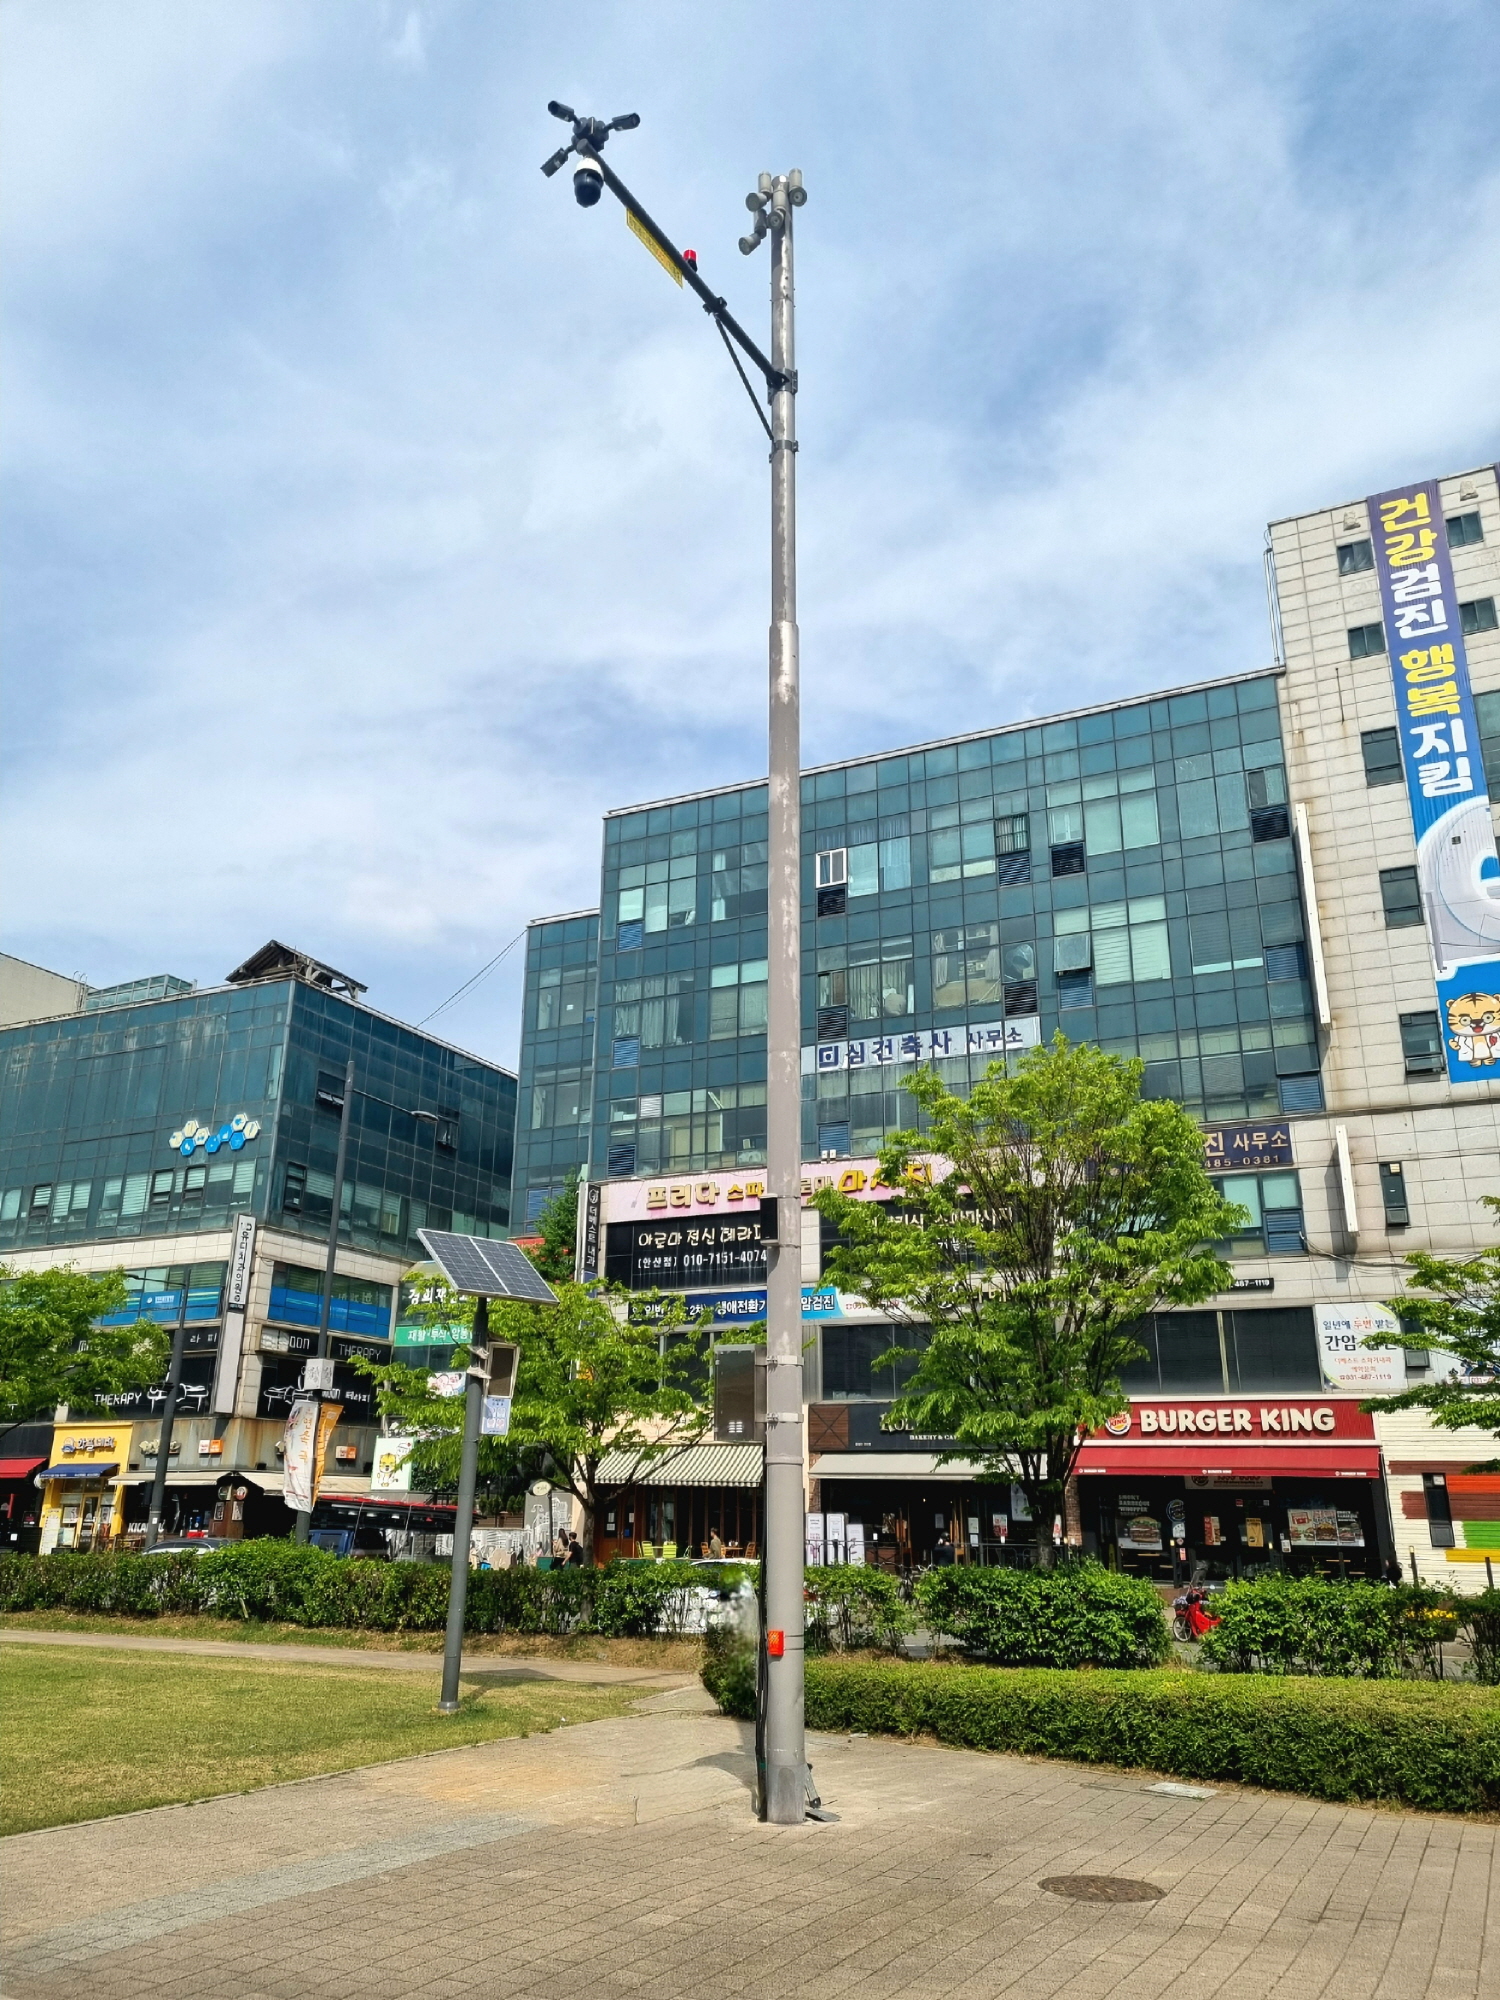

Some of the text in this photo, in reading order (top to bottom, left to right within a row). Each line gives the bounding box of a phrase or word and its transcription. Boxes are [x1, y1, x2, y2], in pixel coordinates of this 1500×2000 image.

[1380, 493, 1448, 639] 건강검진
[968, 1027, 1023, 1049] 사무소
[1233, 1130, 1289, 1151] 사무소
[647, 1182, 765, 1210] 프리다 스파
[638, 1231, 682, 1249] 아로마
[687, 1226, 715, 1246] 전신
[683, 1249, 767, 1267] 010-7151-4074
[1324, 1335, 1357, 1351] 간암
[1140, 1409, 1253, 1432] BURGER
[1260, 1408, 1336, 1432] KING
